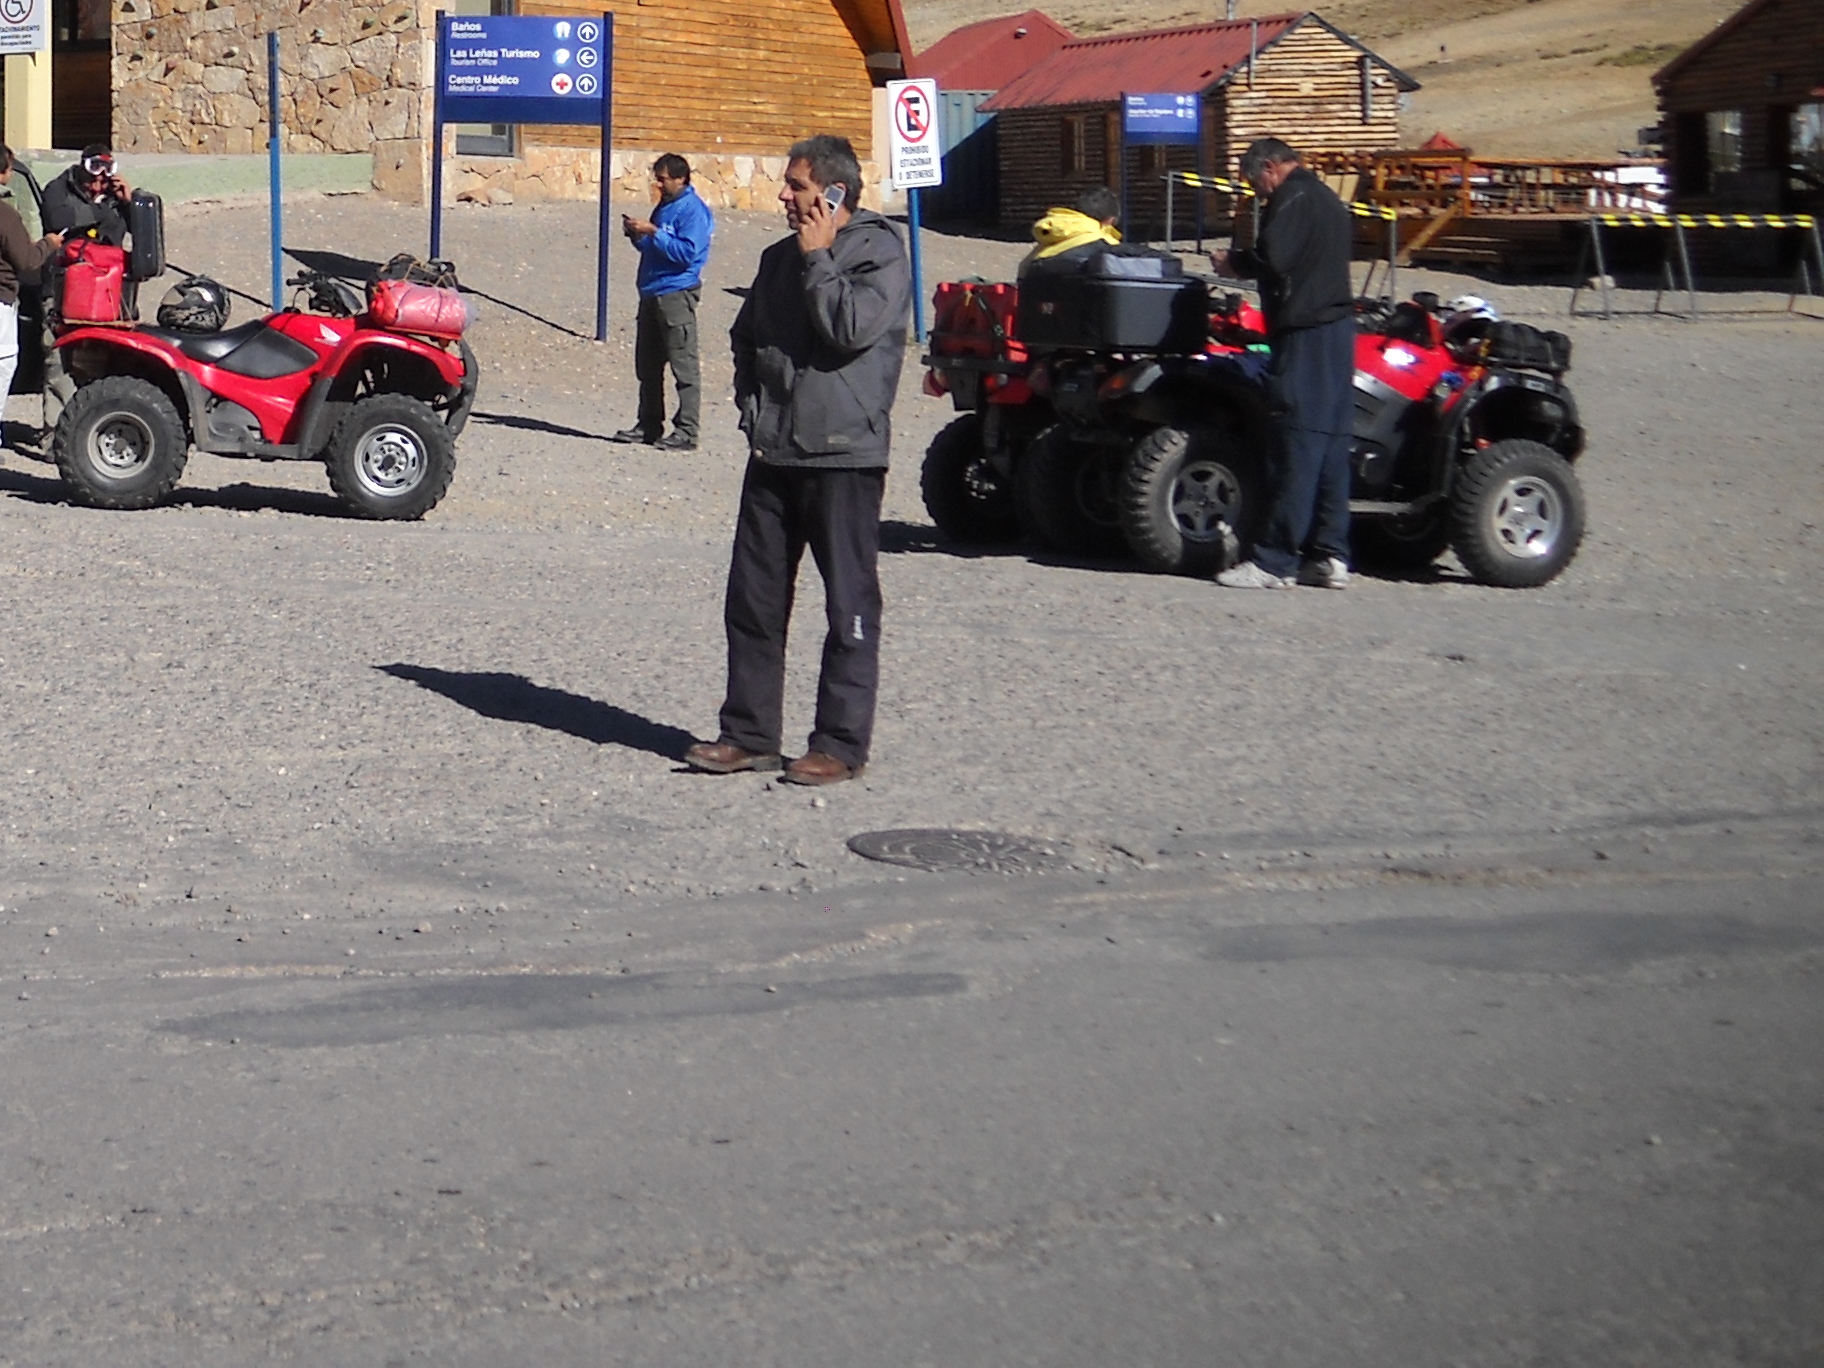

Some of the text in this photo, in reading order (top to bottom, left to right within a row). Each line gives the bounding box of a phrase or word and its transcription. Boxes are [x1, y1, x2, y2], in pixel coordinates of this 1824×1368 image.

[451, 21, 482, 31] Baños
[450, 32, 488, 40] Restrooms
[449, 48, 540, 59] Las Leñas Turismo
[448, 74, 519, 85] Centro Médico
